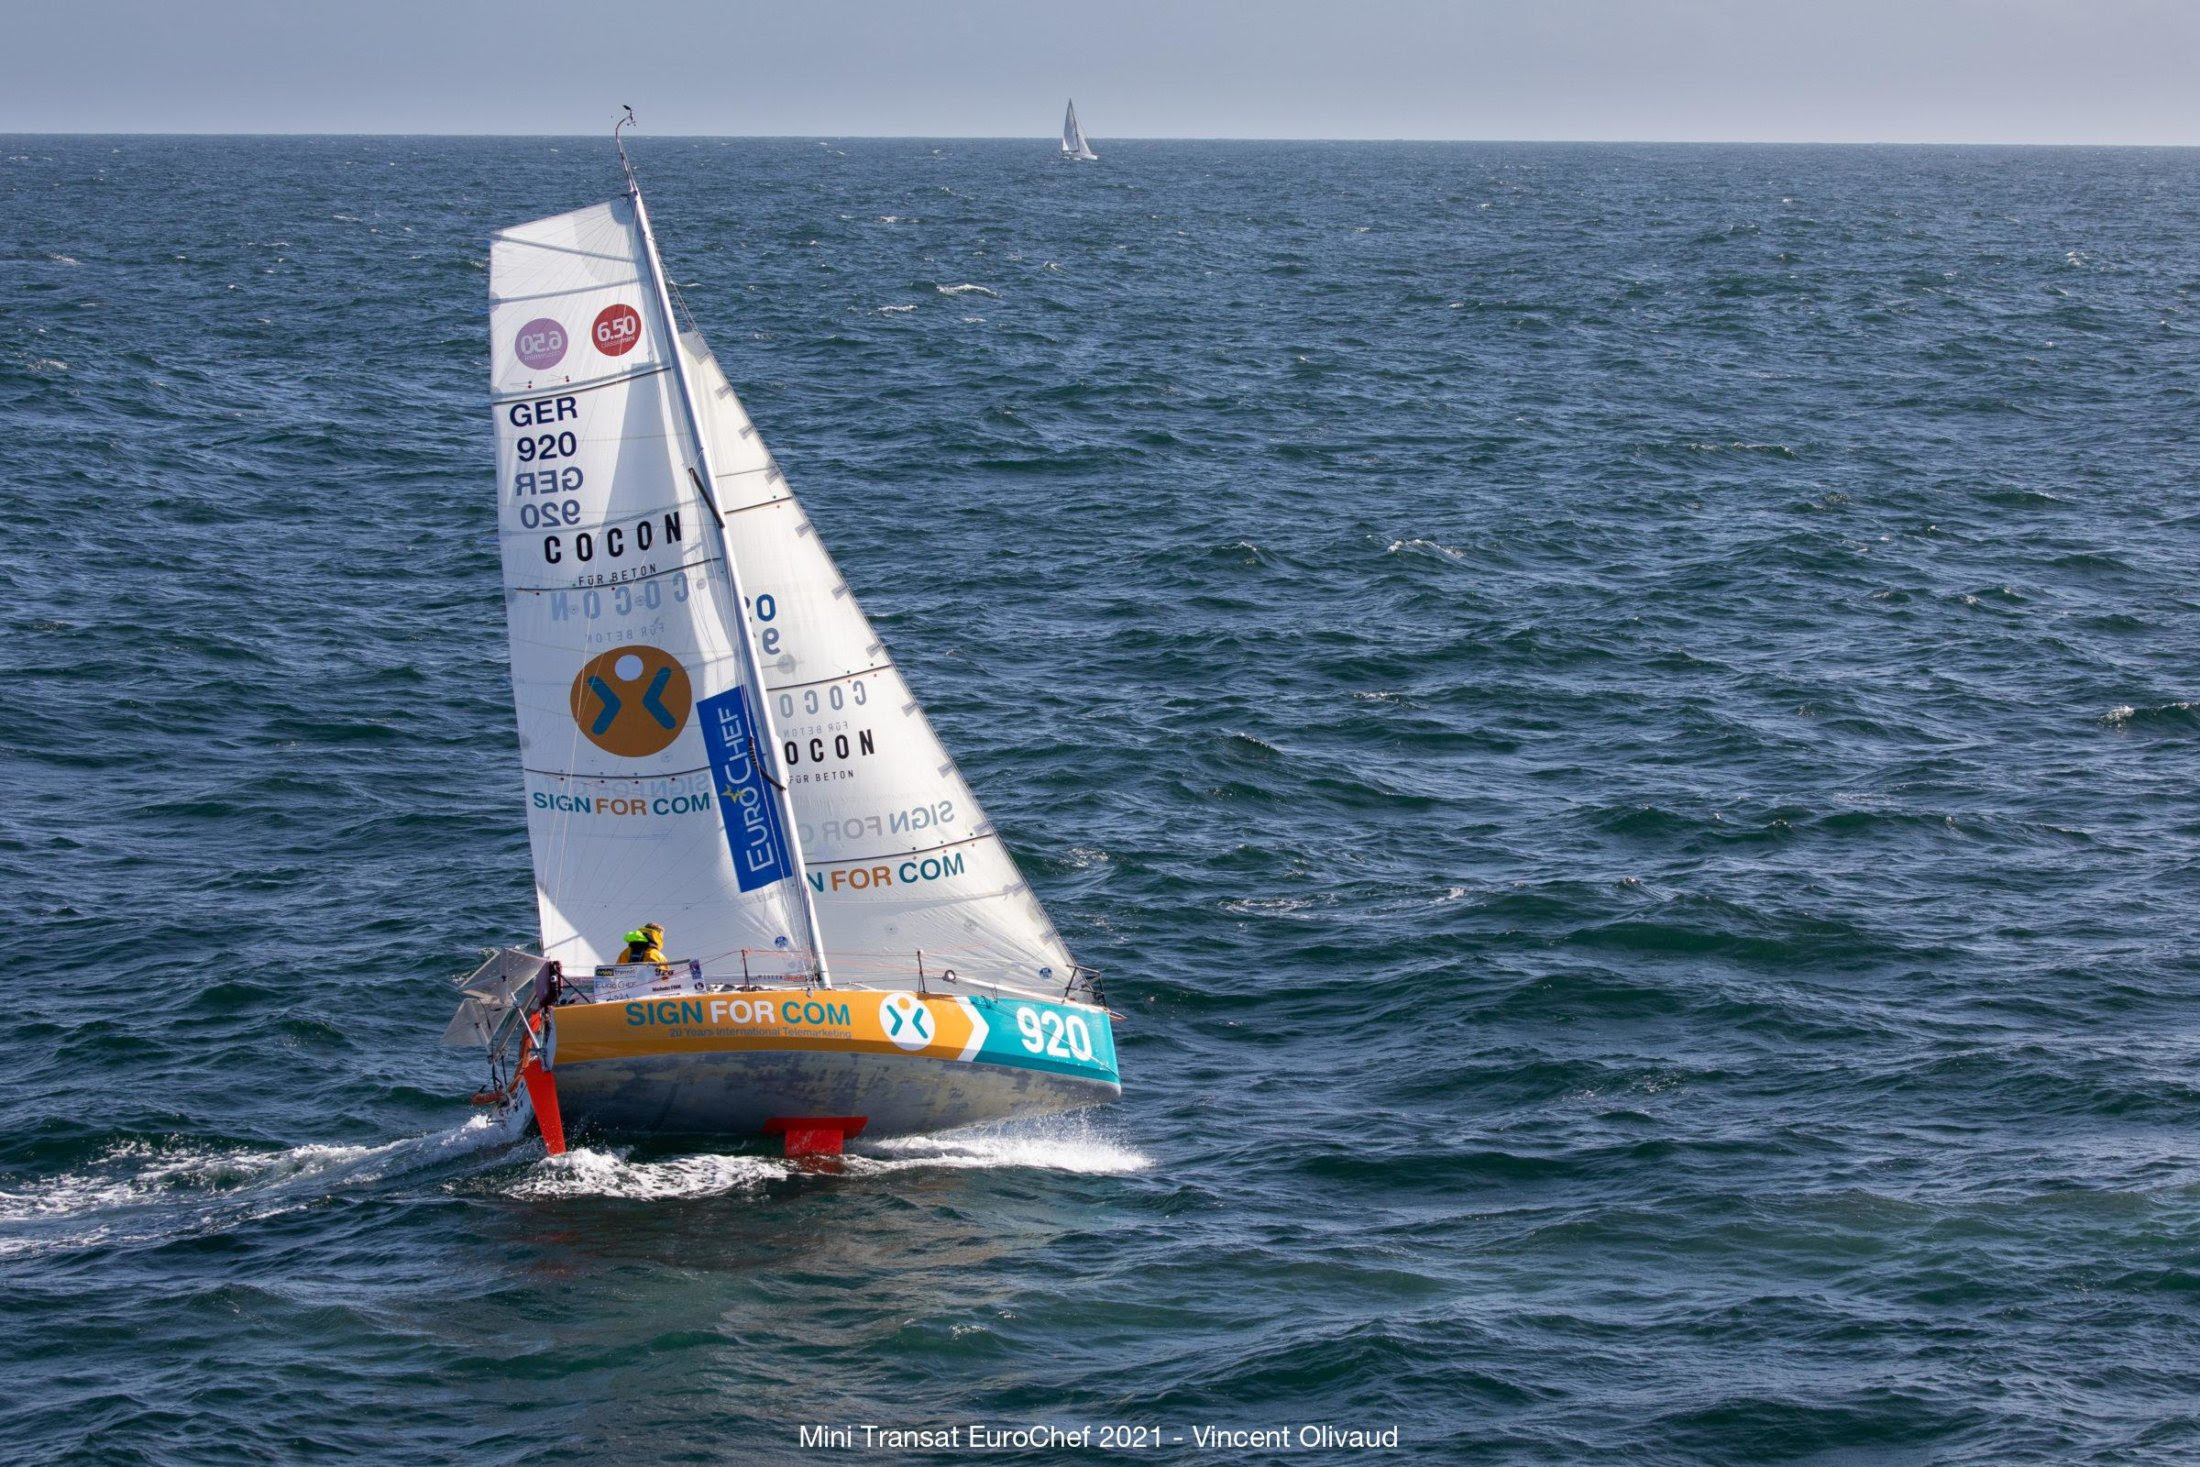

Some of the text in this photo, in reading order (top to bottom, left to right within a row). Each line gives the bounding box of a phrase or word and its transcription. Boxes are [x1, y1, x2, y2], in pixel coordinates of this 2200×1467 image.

[597, 315, 636, 342] 6.50
[509, 396, 578, 427] GER
[517, 431, 577, 462] 920
[544, 511, 682, 564] COCON
[611, 562, 657, 582] BETON
[784, 729, 875, 765] OCON
[815, 769, 854, 782] BETON
[533, 792, 710, 816] SIGN FOR COM
[831, 866, 892, 891] FOR
[899, 852, 964, 883] COM
[625, 1000, 851, 1026] SIGN FOR COM
[716, 1027, 780, 1037] International
[783, 1027, 852, 1041] Telemarketing
[1016, 1006, 1092, 1061] 920
